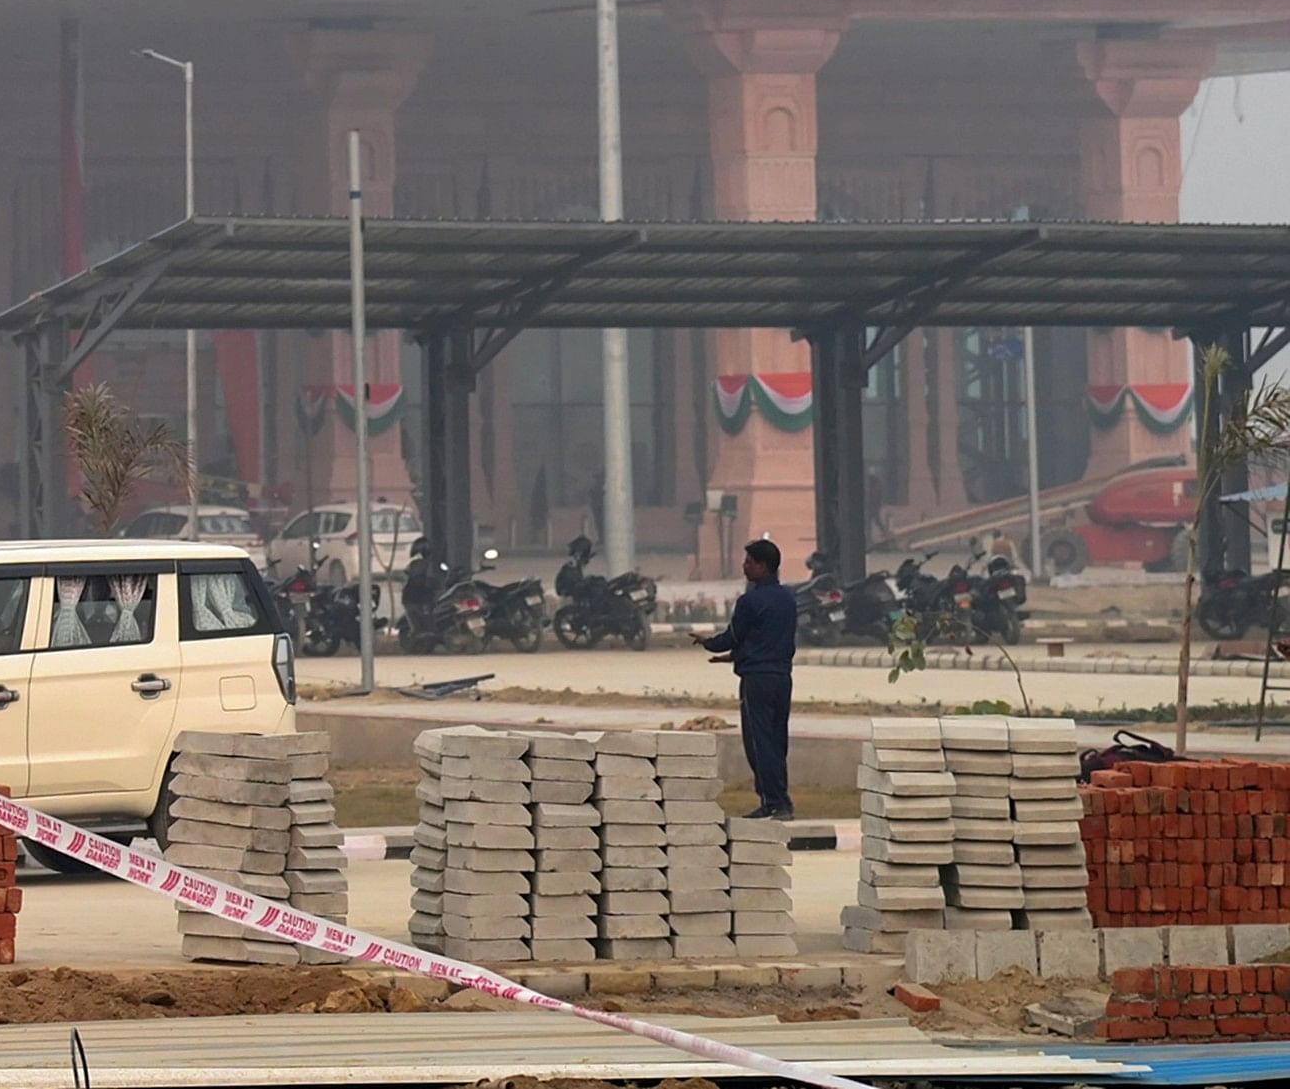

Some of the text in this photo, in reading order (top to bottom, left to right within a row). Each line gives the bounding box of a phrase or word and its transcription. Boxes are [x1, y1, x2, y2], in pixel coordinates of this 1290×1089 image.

[88, 837, 121, 859] CAUTION
[85, 849, 121, 870] DANGER
[129, 853, 156, 872] MEN AT
[183, 876, 218, 897] CAUTION
[179, 887, 215, 908] DANGER
[226, 890, 254, 910] MEN AT
[282, 912, 318, 933] CAUTION
[326, 927, 356, 946] MEN AT
[384, 948, 422, 970] CAUTION
[430, 961, 449, 975] MEN
